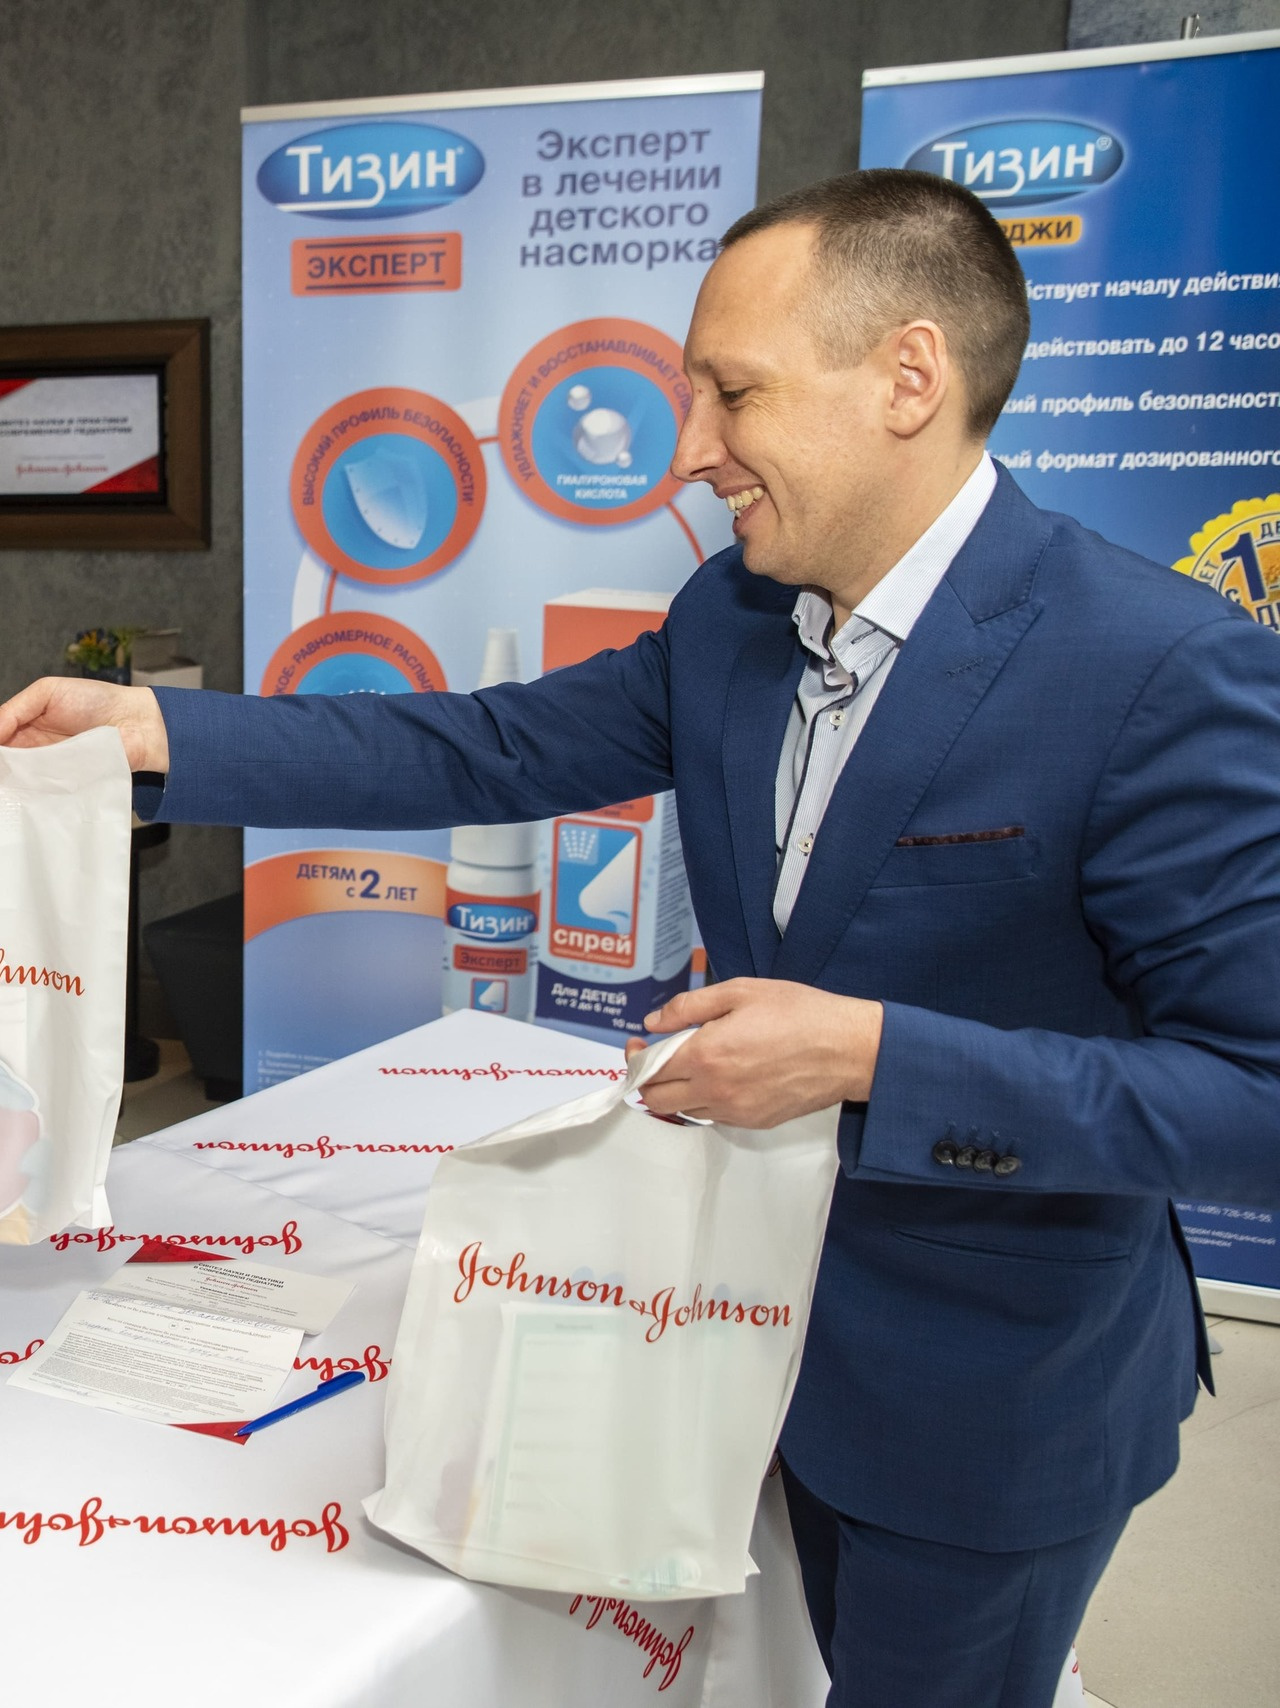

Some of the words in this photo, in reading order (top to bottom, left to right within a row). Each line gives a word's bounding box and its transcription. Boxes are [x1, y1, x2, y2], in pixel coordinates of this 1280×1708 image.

[536, 128, 711, 162] Эксперт
[522, 175, 543, 198] в
[555, 165, 721, 198] лечении
[529, 200, 709, 238] детского
[307, 251, 446, 280] ЭКСПЕРТ
[520, 237, 721, 270] насморка
[1105, 277, 1181, 299] началу
[1023, 337, 1156, 361] действовать
[1158, 336, 1189, 356] до
[1195, 331, 1224, 352] 12
[529, 376, 541, 389] И
[538, 339, 679, 382] ВОССТАНАВЛИВАЕТ
[1041, 393, 1134, 417] профиль
[303, 435, 333, 505] ВЫСОКИЙ
[332, 407, 400, 439] ПРОФИЛЬ
[1036, 450, 1117, 472] формат
[557, 474, 648, 486] ГИАЛУРОНОВАЯ
[575, 488, 627, 500] КИСЛОТА
[293, 629, 394, 665] РАВНОМЕРНОЕ
[296, 862, 356, 882] ДЕТЯМ
[346, 886, 355, 897] с
[359, 869, 381, 899] 2
[386, 886, 419, 903] ЛЕТ
[553, 927, 632, 956] спрей
[460, 952, 521, 969] Эксперт
[551, 983, 580, 998] Для
[581, 987, 628, 1006] ДЕТЕЙ
[555, 998, 568, 1007] от
[569, 999, 577, 1008] 2
[578, 1001, 593, 1012] до
[602, 1006, 623, 1016] лет
